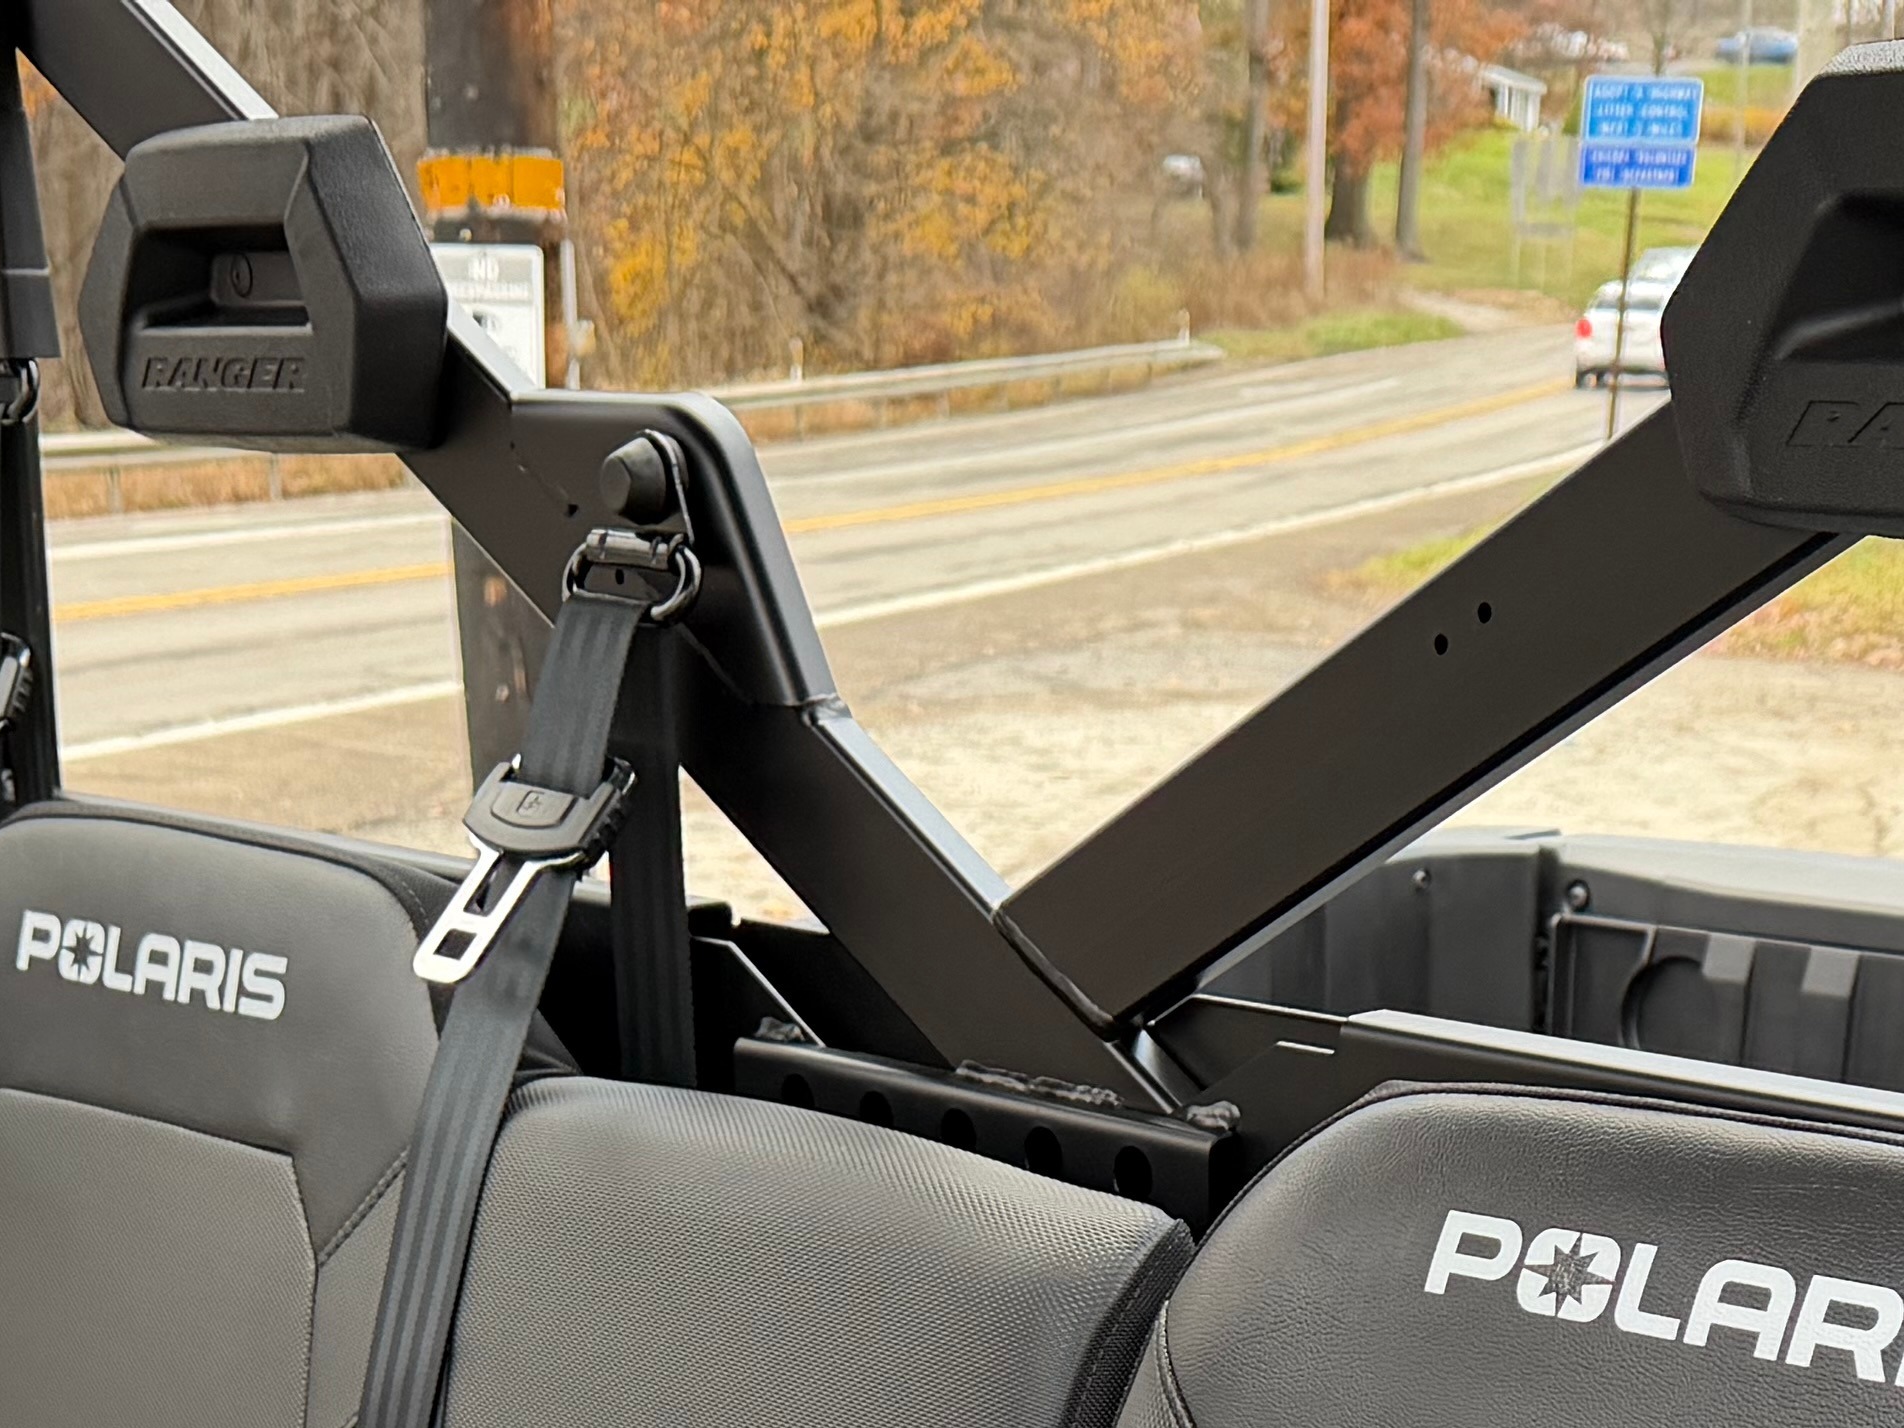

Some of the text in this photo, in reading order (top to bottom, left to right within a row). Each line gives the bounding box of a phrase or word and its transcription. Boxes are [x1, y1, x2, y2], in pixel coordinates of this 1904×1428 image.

[468, 254, 500, 283] NO
[140, 356, 306, 393] RANGER
[15, 908, 288, 1021] POLARIS
